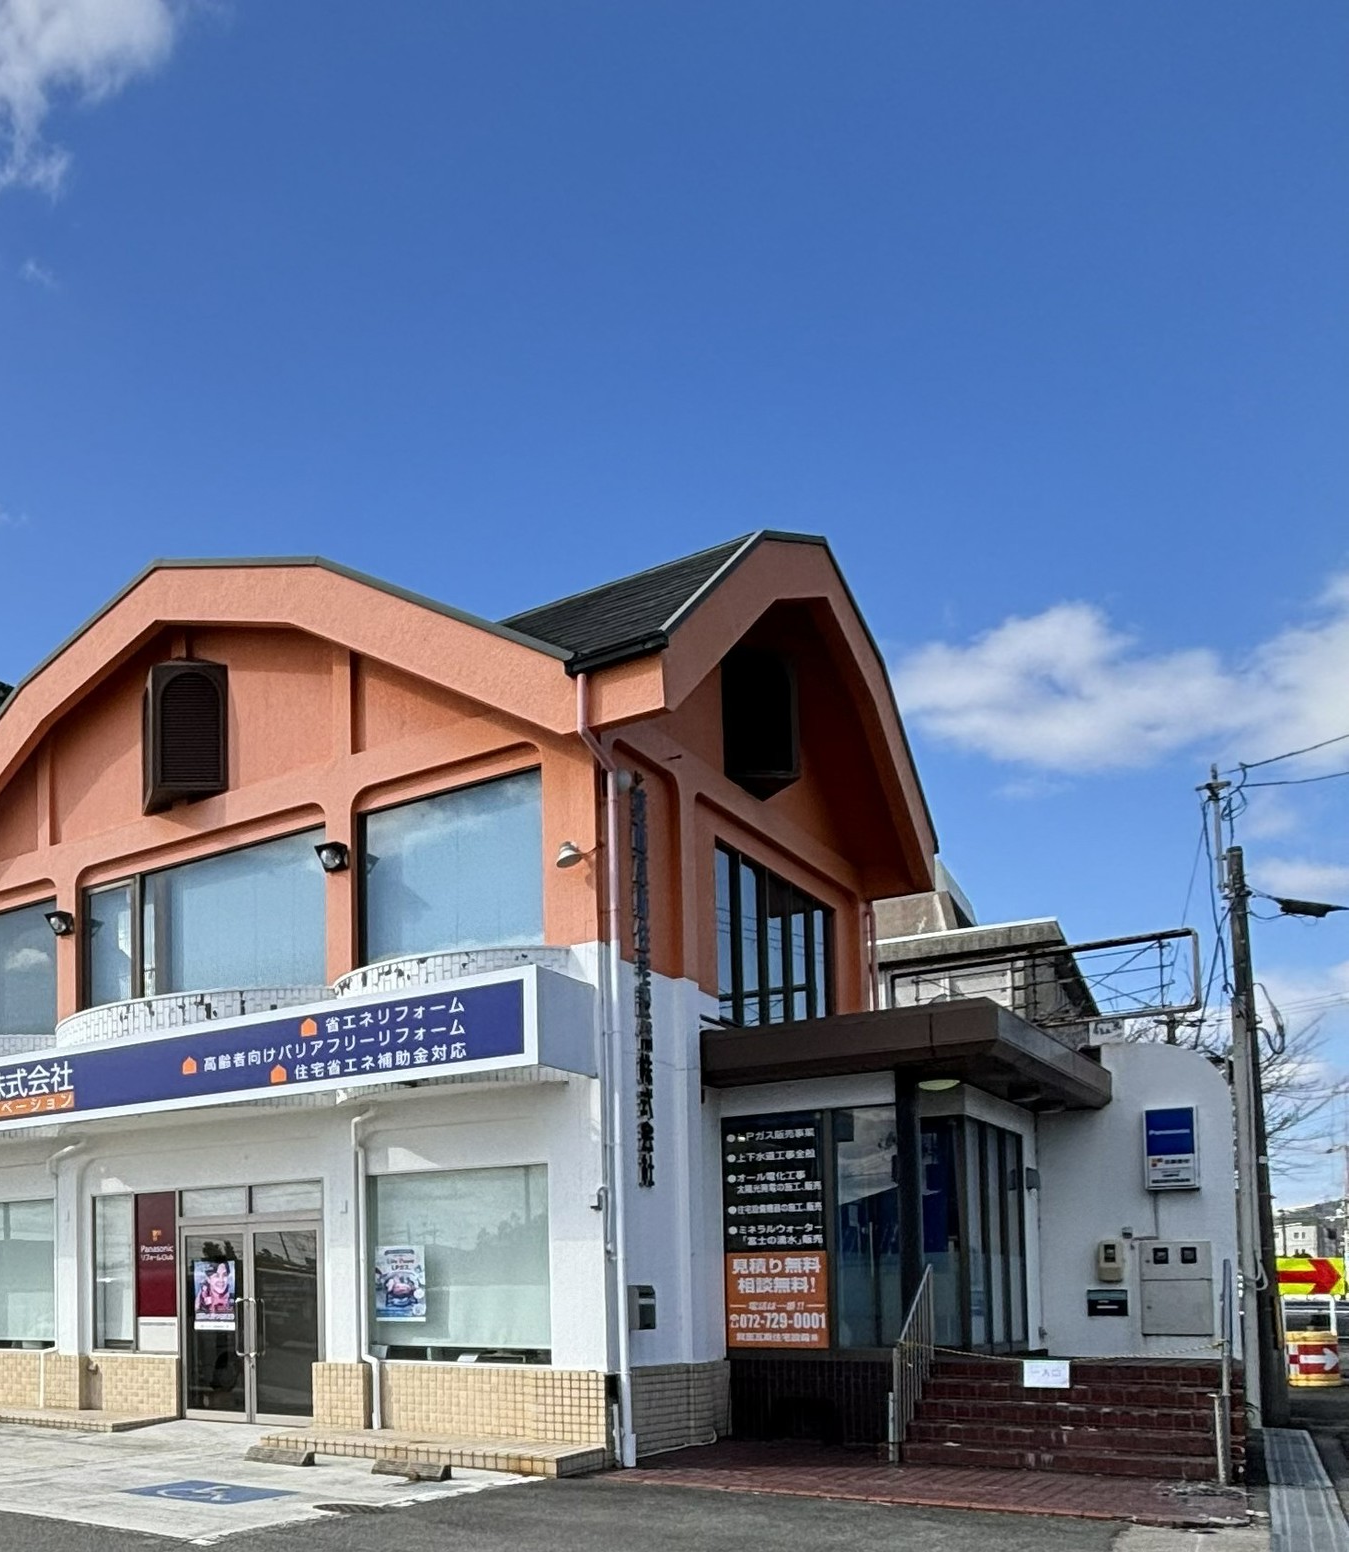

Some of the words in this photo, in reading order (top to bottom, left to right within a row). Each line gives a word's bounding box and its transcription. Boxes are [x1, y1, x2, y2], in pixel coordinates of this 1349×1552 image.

[325, 996, 465, 1033] 省エネリフォーム
[203, 1018, 465, 1073] 高齢者向けバリアフリーリフォーム
[294, 1042, 467, 1080] 住宅省エネ補助金対応
[739, 1223, 823, 1235] ミネラルウォーター
[140, 1244, 174, 1253] Panasonic
[732, 1257, 821, 1275] 見積り無料
[740, 1312, 826, 1329] 072-729-0001
